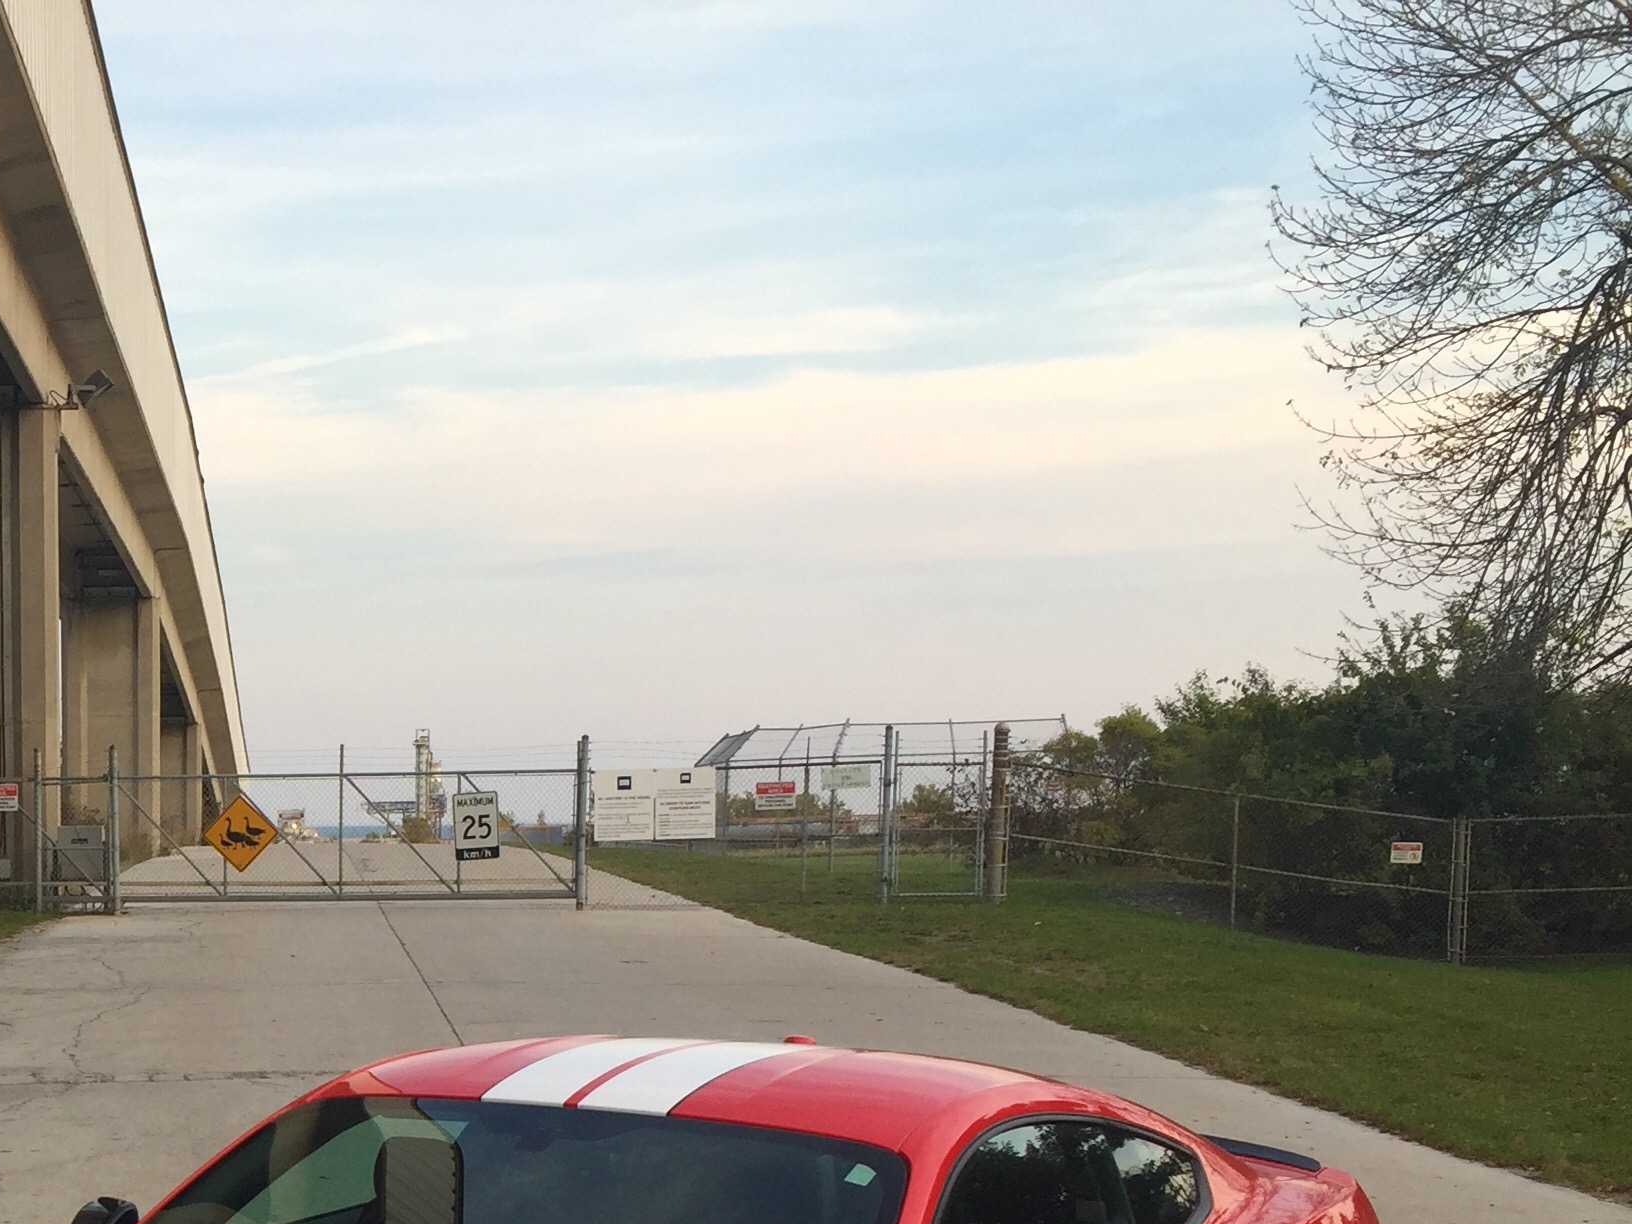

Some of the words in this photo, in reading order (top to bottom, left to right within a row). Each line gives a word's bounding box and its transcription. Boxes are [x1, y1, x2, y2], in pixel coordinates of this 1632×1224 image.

[457, 797, 494, 807] MAXIMUM
[462, 814, 492, 840] 25
[463, 849, 492, 859] km/h
